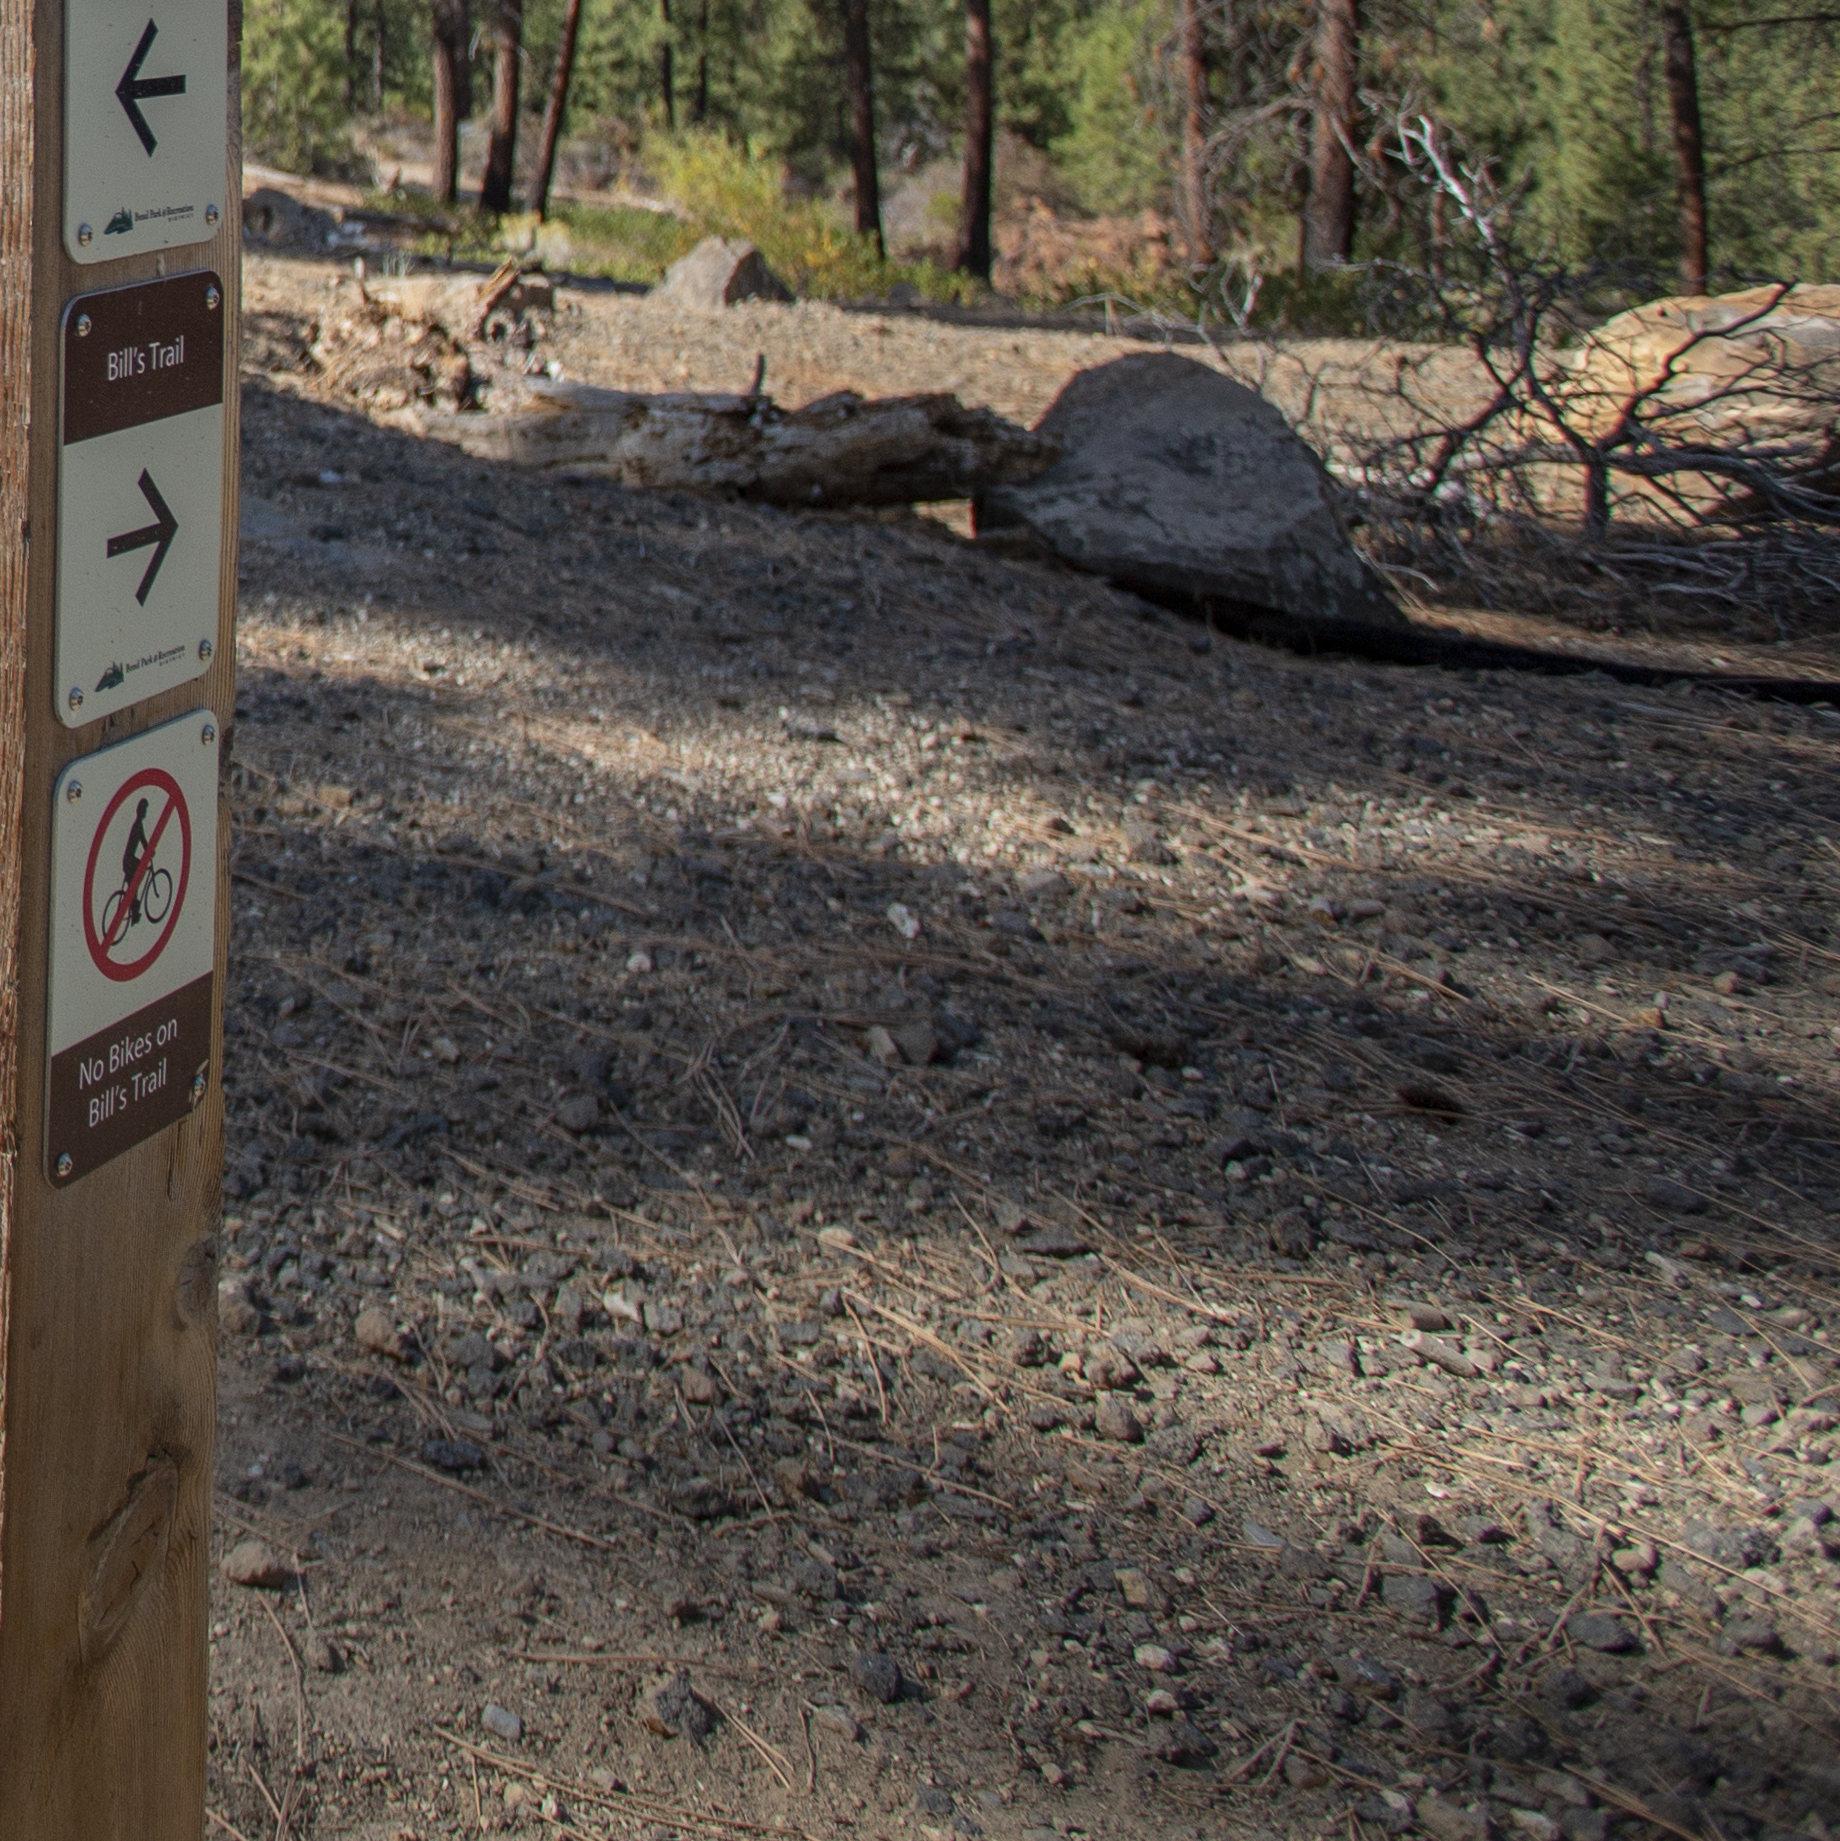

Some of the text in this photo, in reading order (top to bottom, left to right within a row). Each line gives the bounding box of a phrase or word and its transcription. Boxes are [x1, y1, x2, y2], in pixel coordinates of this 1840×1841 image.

[107, 335, 185, 381] Bill's Trail
[79, 1019, 177, 1090] No Bikes on
[89, 1057, 167, 1128] Bill's Trail
